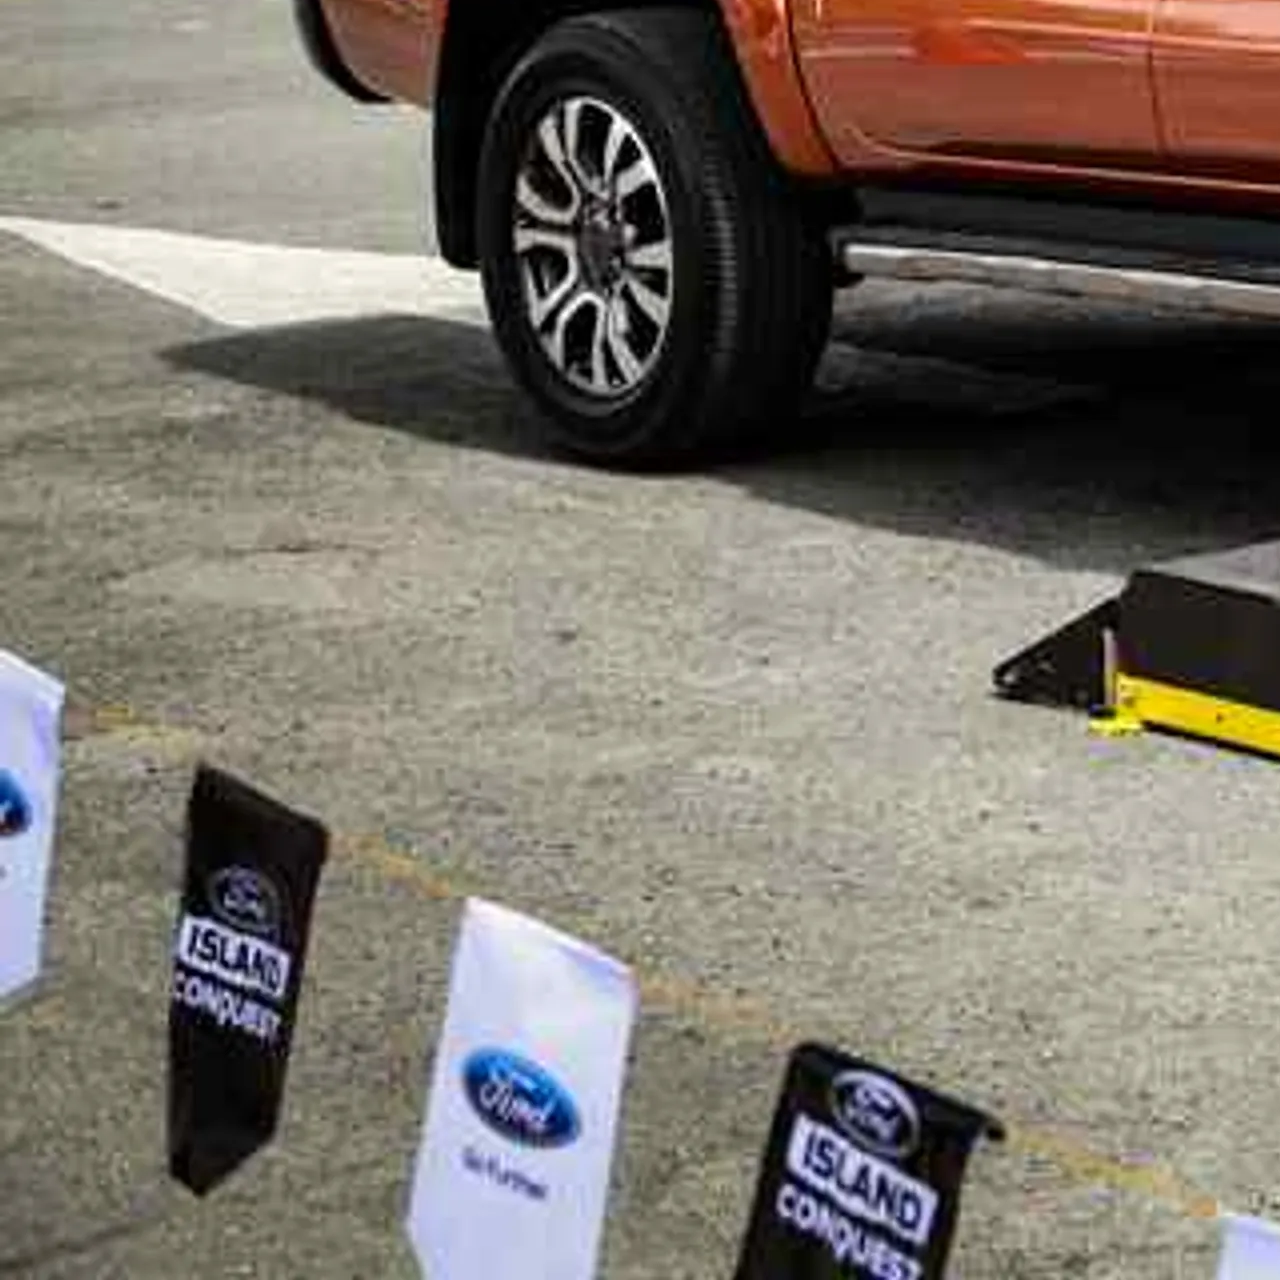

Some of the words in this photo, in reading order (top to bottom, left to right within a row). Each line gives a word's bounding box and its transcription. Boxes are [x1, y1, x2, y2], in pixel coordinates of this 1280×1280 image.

[186, 925, 282, 993] ISLAND
[478, 1066, 559, 1134] Ford
[803, 1132, 924, 1232] ISLAND
